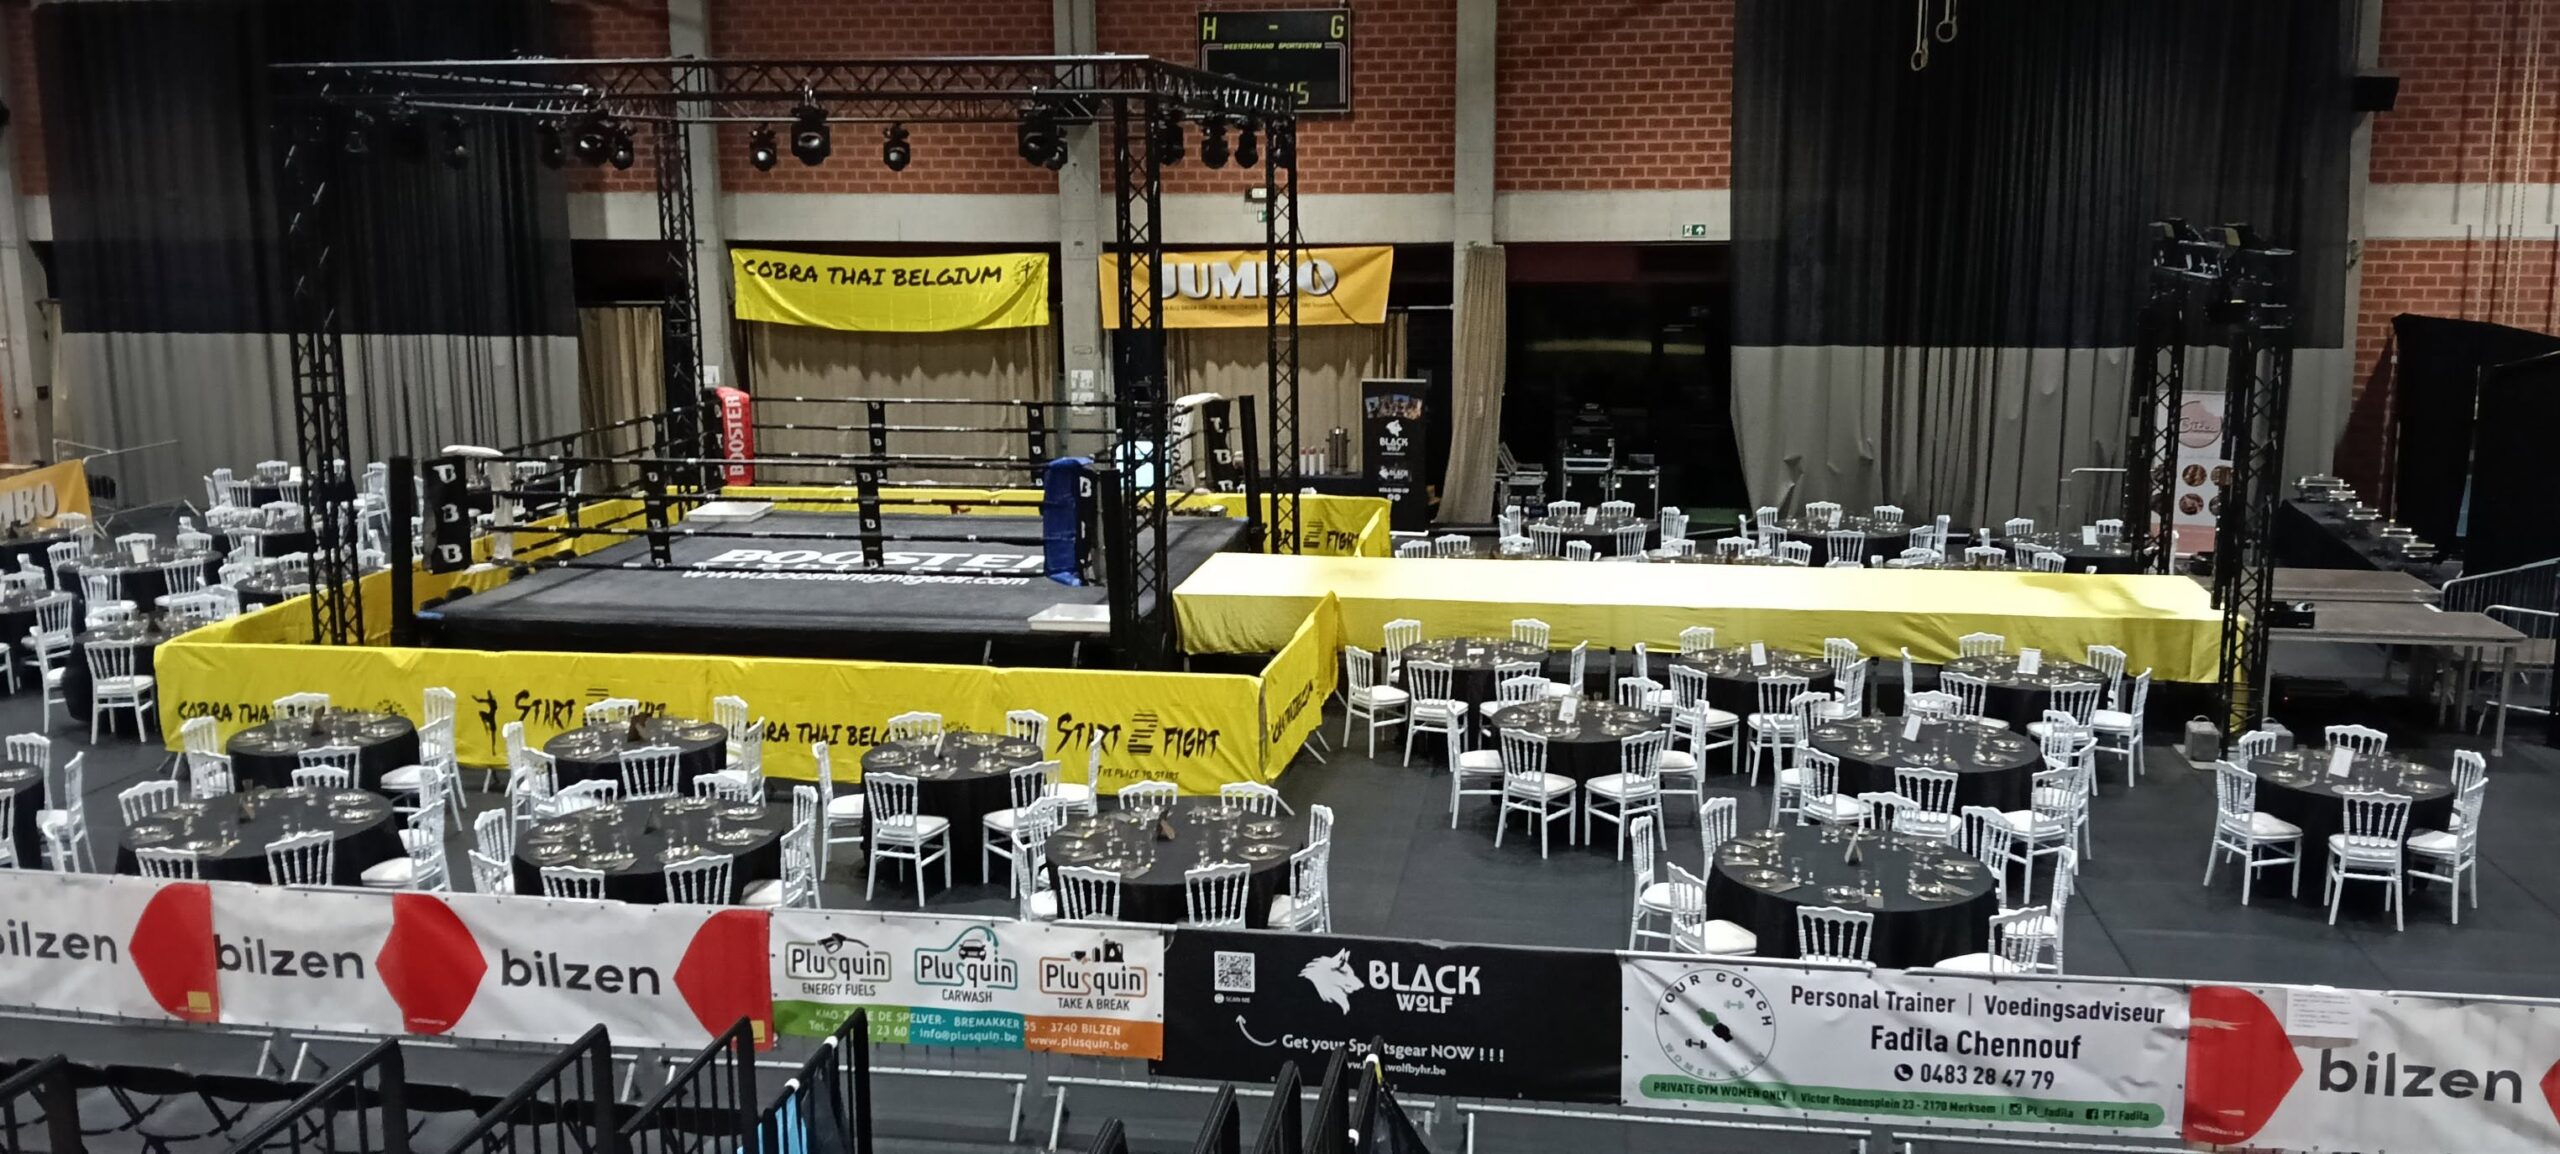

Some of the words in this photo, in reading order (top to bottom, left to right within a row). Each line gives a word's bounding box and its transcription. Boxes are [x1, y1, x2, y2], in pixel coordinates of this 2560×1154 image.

[1202, 16, 1217, 41] H
[1330, 14, 1345, 39] G
[743, 258, 818, 283] COBRA
[826, 266, 885, 286] THAI
[892, 266, 1001, 287] BELGIUM
[515, 690, 576, 730] START
[796, 723, 843, 745] THAI
[1055, 712, 1122, 756] START
[1163, 727, 1221, 761] FIGHT
[0, 919, 118, 964] ilzen
[213, 934, 365, 980] bilzen
[500, 948, 661, 996] bilzen
[792, 948, 885, 981] Plusquin
[921, 955, 1012, 988] Plusquin
[1046, 964, 1141, 996] Plusquin
[1368, 960, 1481, 995] BLACK
[802, 982, 842, 995] ENERGY
[845, 984, 876, 996] FUELS
[942, 989, 993, 1003] CARWASH
[1058, 997, 1083, 1009] TAKE
[1086, 999, 1093, 1009] A
[1096, 999, 1130, 1011] BREAK
[1396, 993, 1453, 1014] WOLF
[1658, 974, 1701, 1017] YOUR
[1715, 972, 1773, 1027] COACH
[1791, 985, 1880, 1010] Personal
[1885, 990, 1957, 1014] Trainer
[1984, 995, 2166, 1024] Voedingsadviseur
[878, 1011, 892, 1022] DE
[954, 1016, 1020, 1029] BREMAKKER
[1050, 1022, 1078, 1033] 3740
[1081, 1024, 1121, 1036] BILZEN
[1030, 1037, 1129, 1051] www.plusquin.be
[1282, 1034, 1308, 1049] Get
[1431, 1045, 1475, 1060] NOW
[1870, 1024, 1948, 1052] Fadila
[1956, 1030, 2082, 1060] Chennouf
[1920, 1063, 1967, 1084] 0483
[1973, 1067, 1996, 1085] 28
[2001, 1069, 2026, 1088] 47
[2031, 1070, 2055, 1090] 79
[2319, 1048, 2522, 1103] bilzen
[1653, 1082, 1695, 1094] PRIVATE
[1697, 1085, 1718, 1096] GYM
[1720, 1086, 1760, 1099] WOMEN
[1761, 1089, 1787, 1101] ONLY
[1800, 1092, 1831, 1104] Victor
[1902, 1099, 1914, 1110] 23
[1923, 1100, 1947, 1111] 2170
[1950, 1102, 1996, 1114] Merksem
[2103, 1110, 2116, 1120] PT
[2119, 1110, 2150, 1121] Fadila
